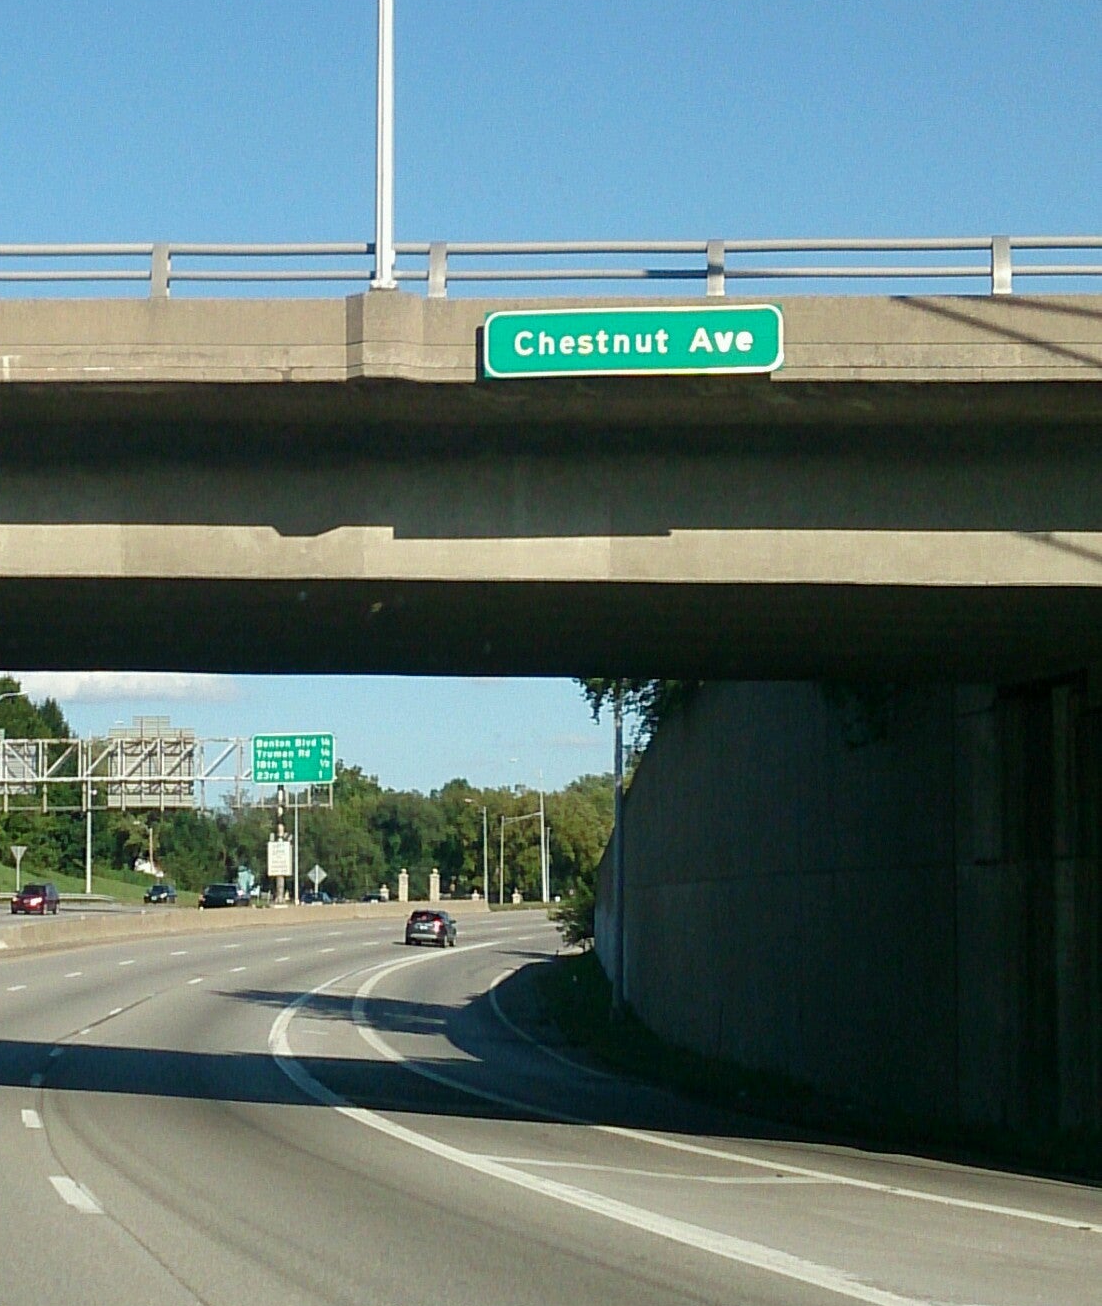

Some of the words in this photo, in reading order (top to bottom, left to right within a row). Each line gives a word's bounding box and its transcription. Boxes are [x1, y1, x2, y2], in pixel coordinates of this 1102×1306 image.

[514, 329, 669, 356] Chestnut
[689, 327, 753, 353] Ave
[256, 739, 291, 748] Benton
[295, 738, 317, 747] Blvd
[256, 749, 294, 758] Truman
[298, 749, 310, 758] Rd
[282, 760, 293, 769] St
[256, 771, 280, 780] 23rd
[284, 771, 295, 780] St
